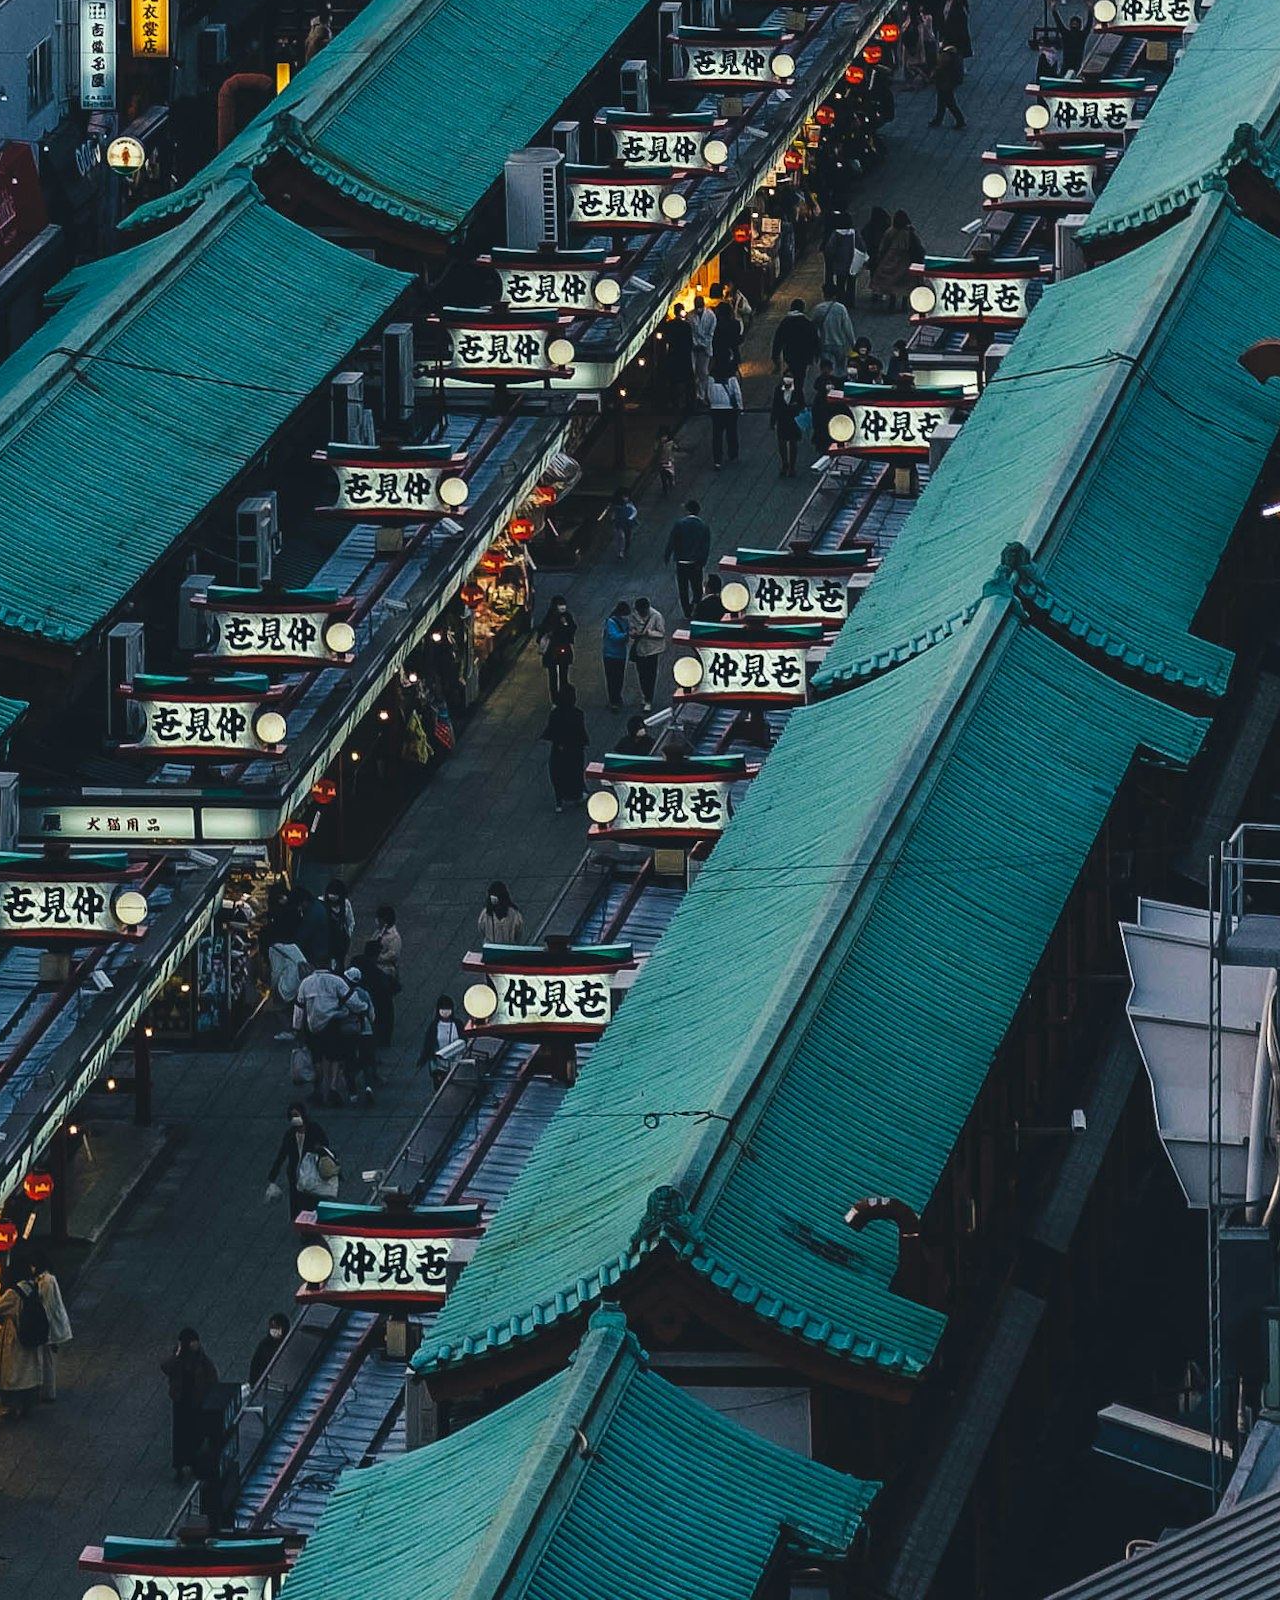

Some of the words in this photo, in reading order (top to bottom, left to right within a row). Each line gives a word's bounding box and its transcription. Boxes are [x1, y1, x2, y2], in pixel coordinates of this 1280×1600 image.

[1054, 102, 1127, 130] 仲見世
[1012, 169, 1090, 199] 仲見世
[942, 283, 1021, 312] 仲見世
[754, 577, 845, 613] 仲見世
[709, 653, 803, 688] 仲見世
[624, 787, 722, 824] 仲見世
[87, 817, 160, 831] 犬猫用品
[504, 978, 607, 1020] 仲見世
